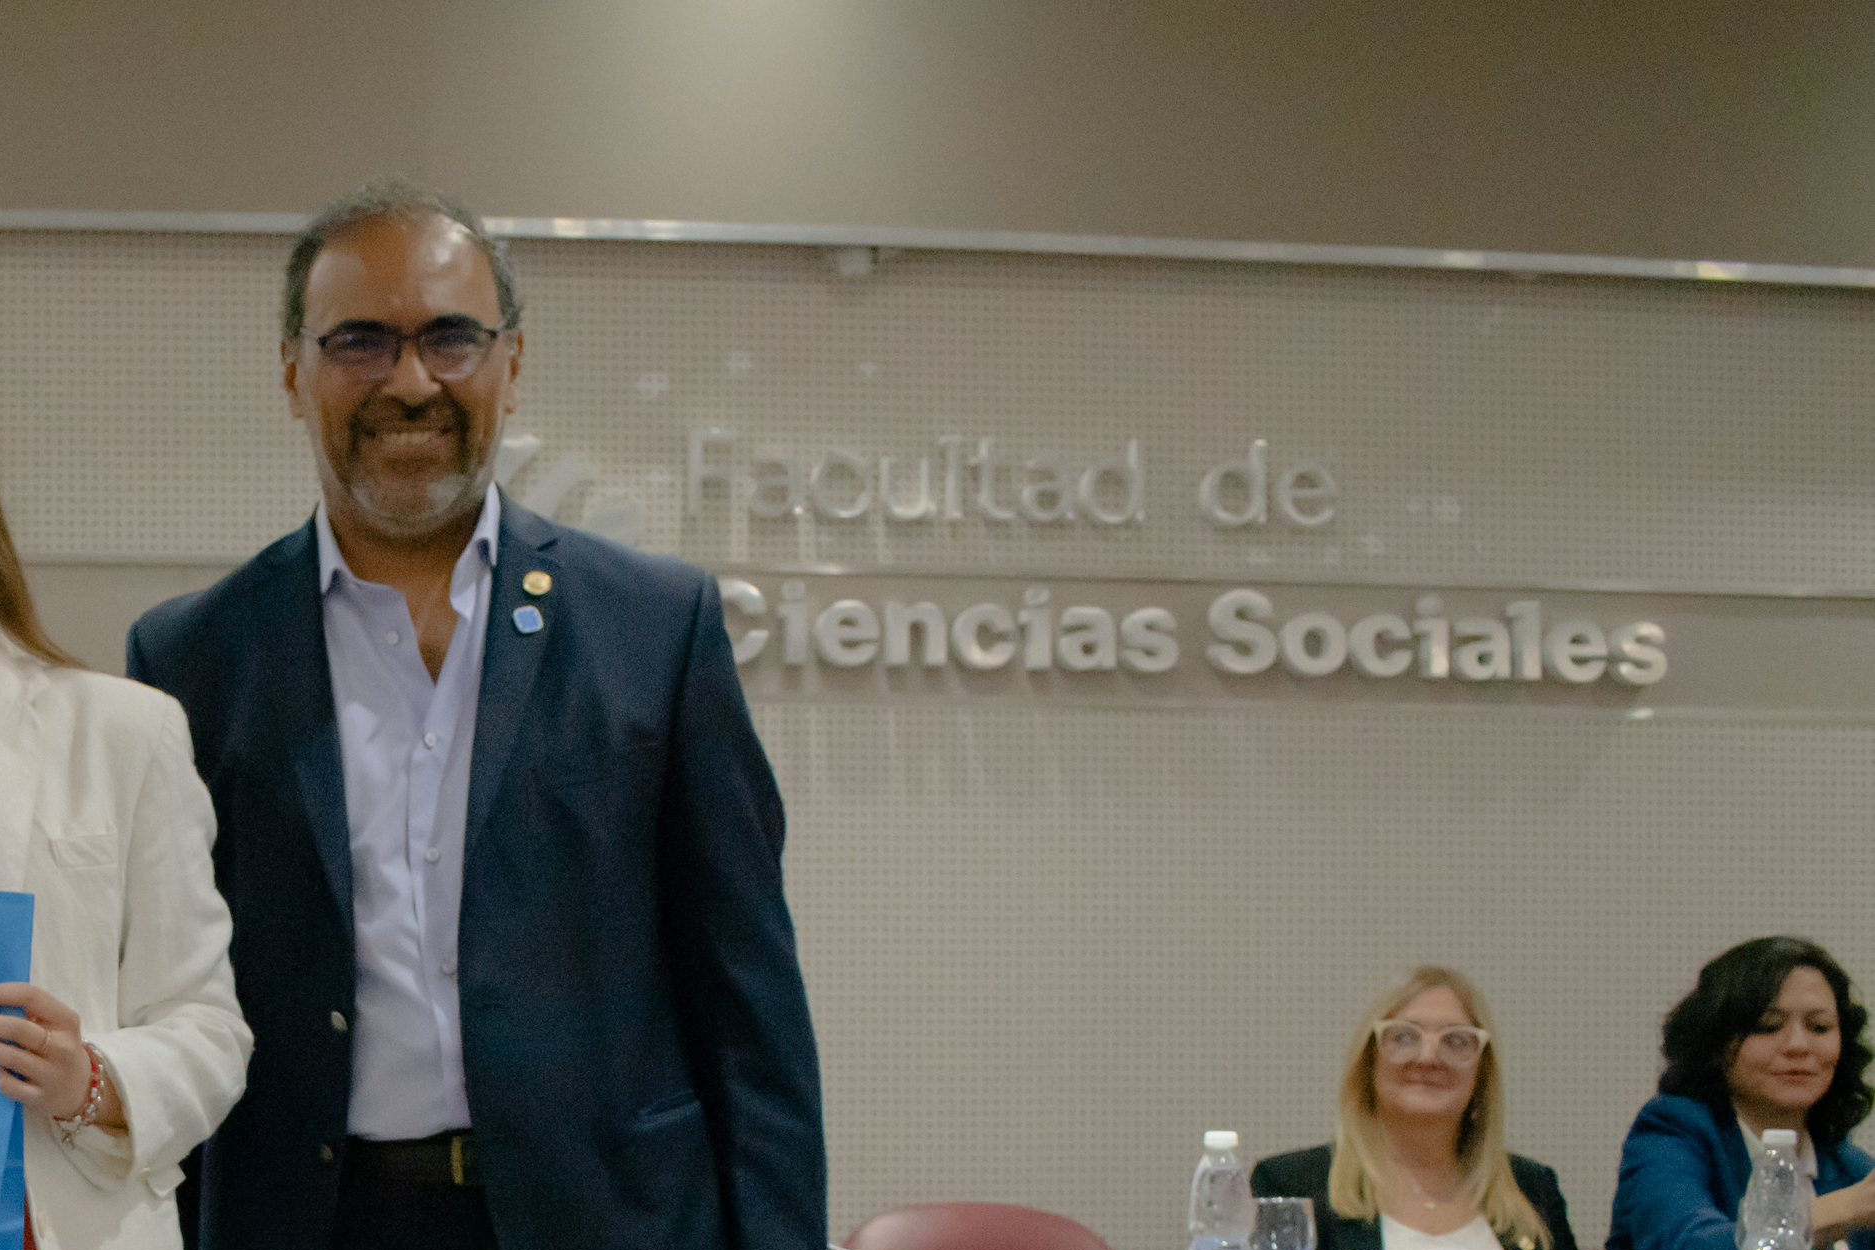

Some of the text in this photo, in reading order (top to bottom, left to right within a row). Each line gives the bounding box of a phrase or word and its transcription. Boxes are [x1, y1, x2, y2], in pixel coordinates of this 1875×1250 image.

[685, 428, 1338, 527] Facultad de
[719, 578, 1669, 686] Ciencias Sociales
